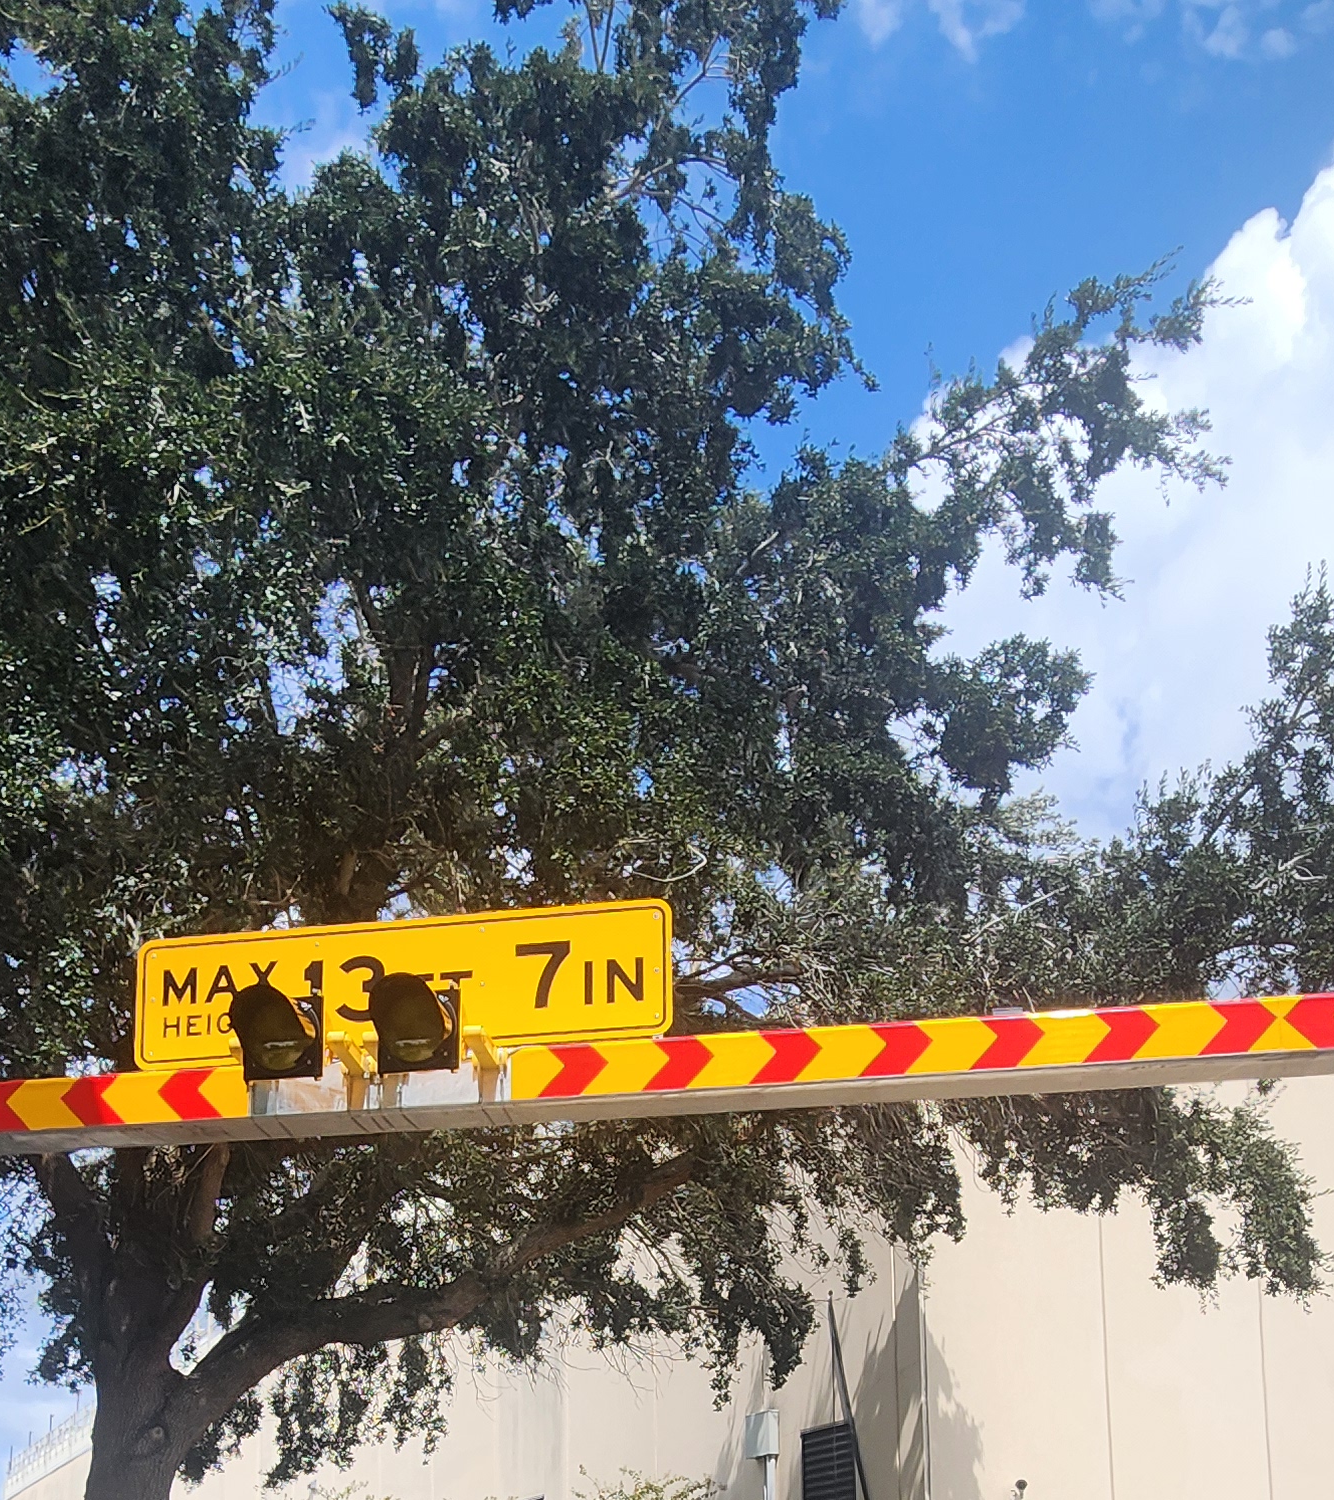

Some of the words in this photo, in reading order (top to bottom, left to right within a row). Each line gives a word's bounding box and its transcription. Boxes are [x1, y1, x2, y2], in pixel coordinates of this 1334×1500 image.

[162, 960, 278, 1007] MAX
[515, 940, 571, 1009] 7
[584, 956, 645, 1007] IN
[163, 1014, 233, 1038] HEIG
